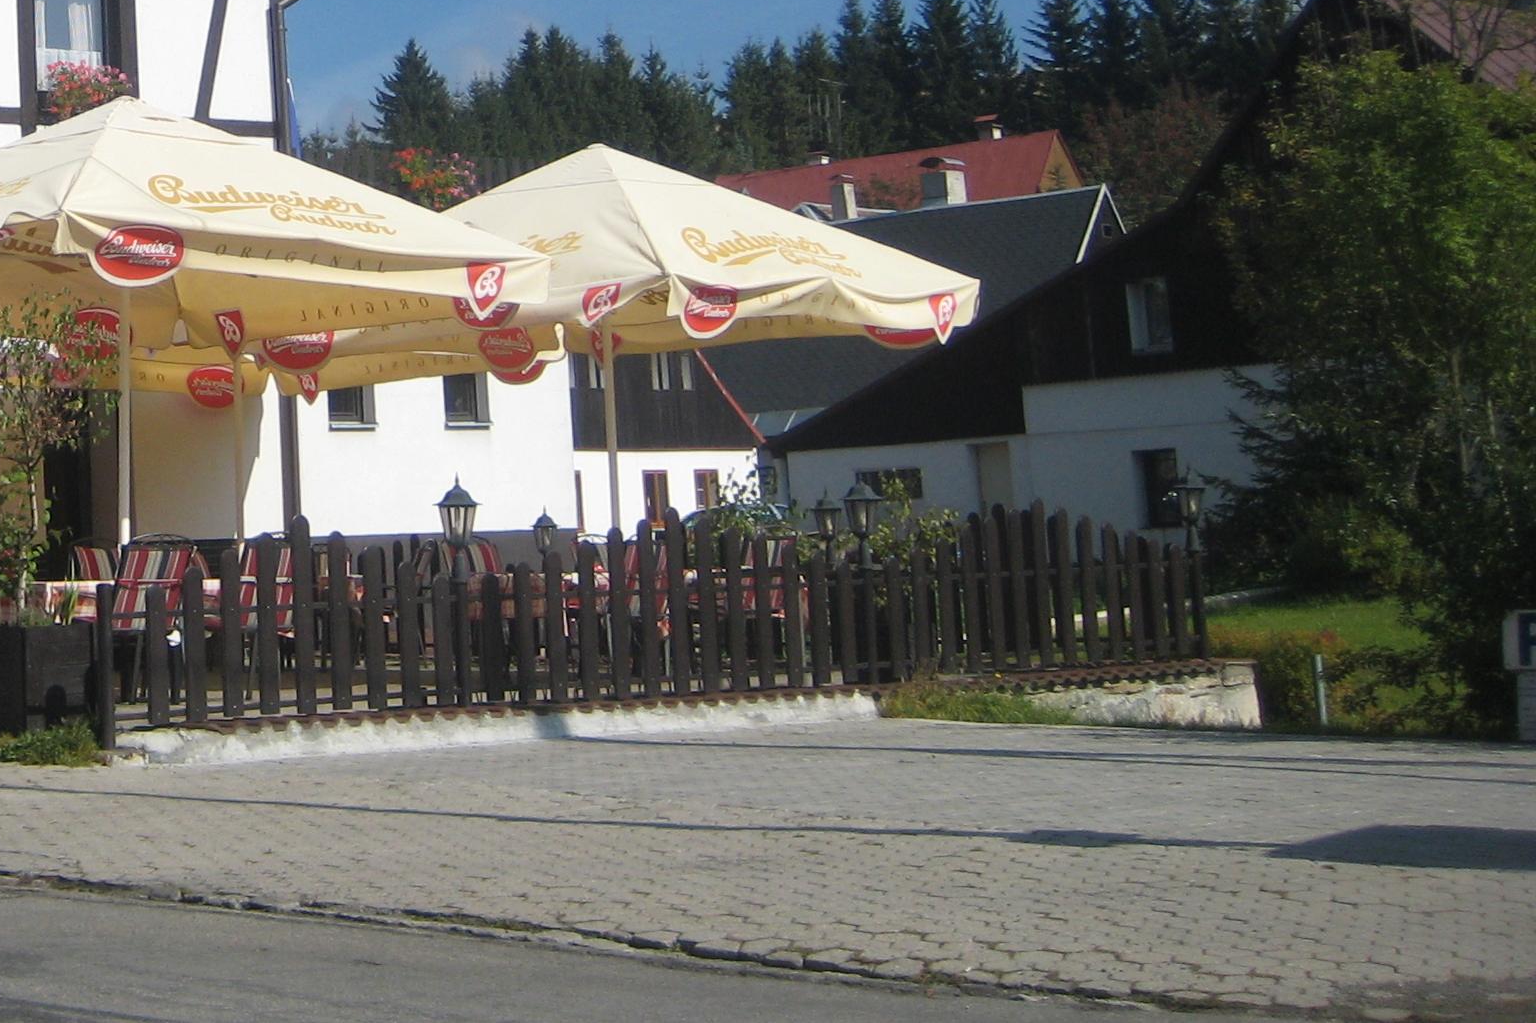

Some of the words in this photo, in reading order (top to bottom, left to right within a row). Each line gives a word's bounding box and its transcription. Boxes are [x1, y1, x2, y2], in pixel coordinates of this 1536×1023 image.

[148, 174, 385, 221] Budweiser
[270, 204, 396, 236] Budvar
[99, 234, 176, 258] Budweiser
[215, 243, 385, 273] ORIGINAL
[681, 227, 847, 263] Budweiser
